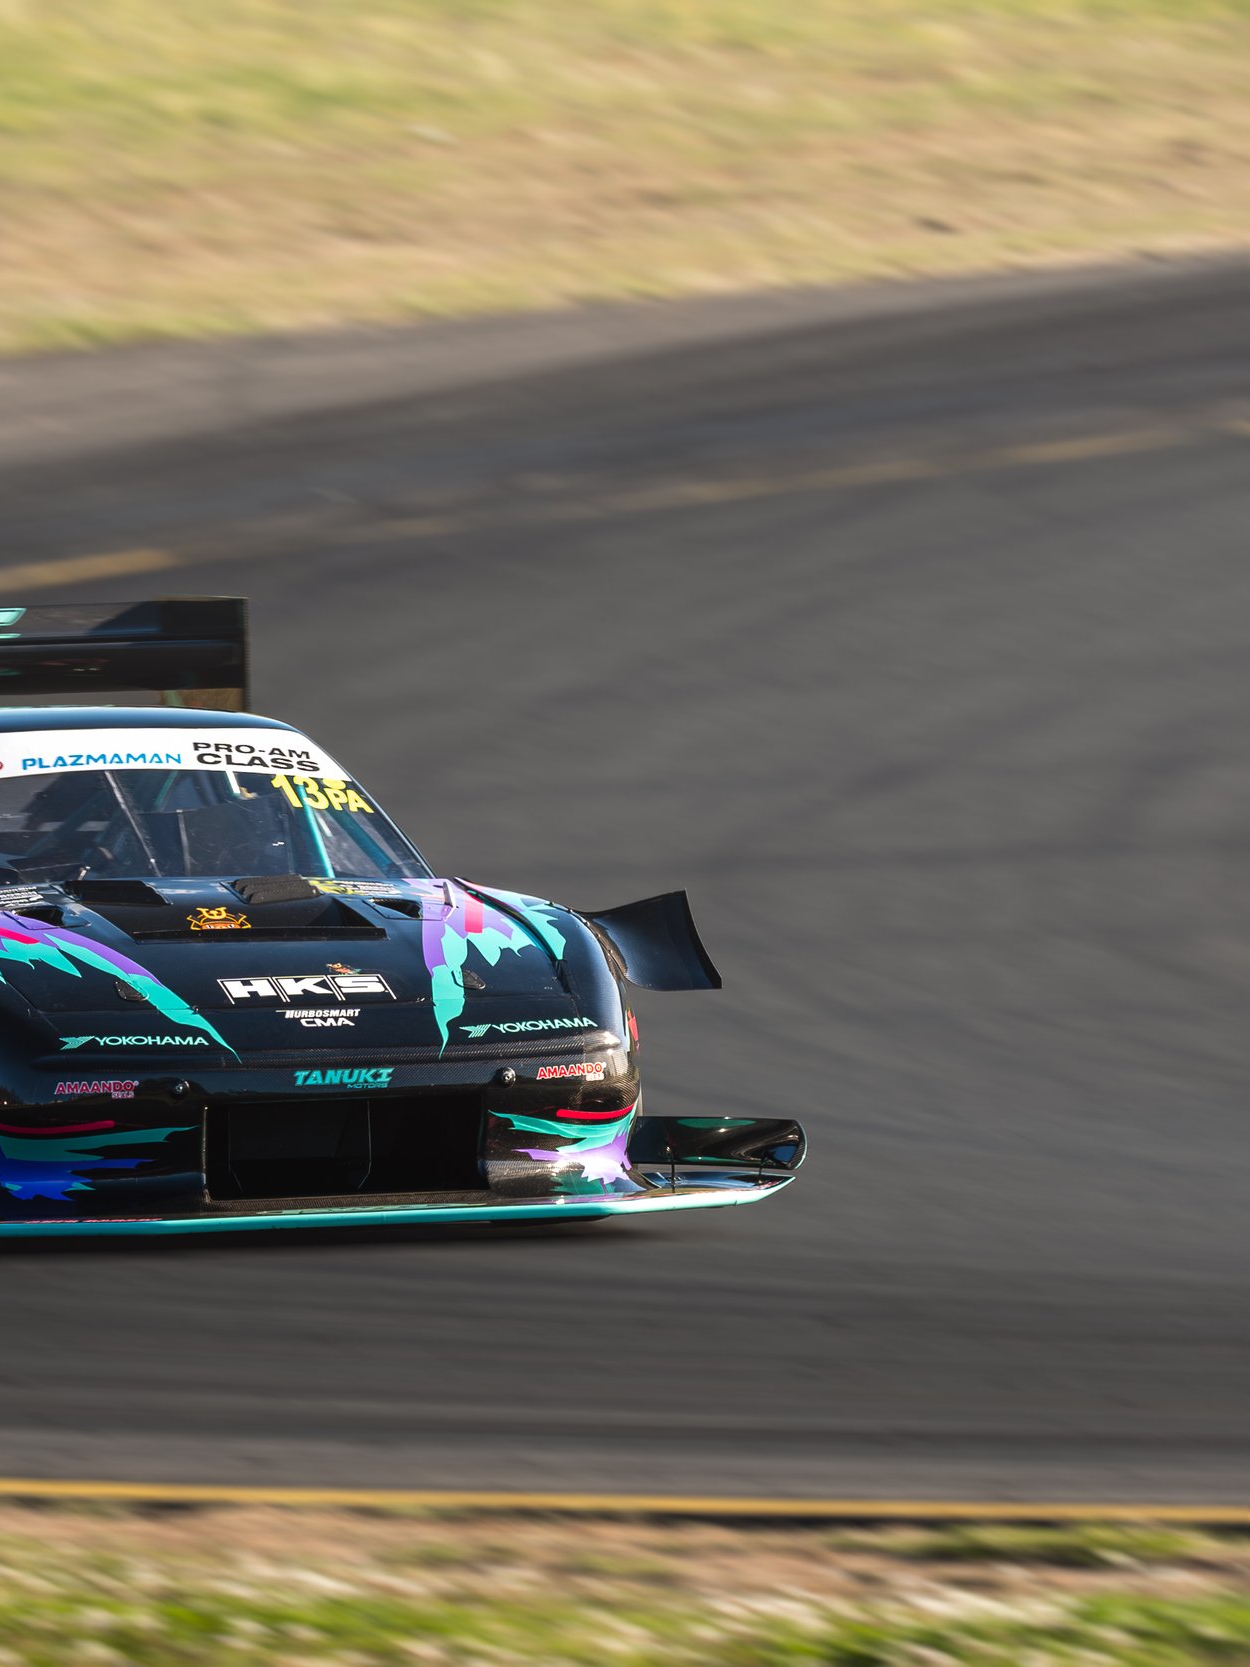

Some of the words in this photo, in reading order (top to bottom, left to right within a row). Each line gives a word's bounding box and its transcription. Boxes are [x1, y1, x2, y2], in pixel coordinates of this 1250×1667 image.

[193, 742, 310, 759] PRO-AM
[22, 753, 182, 770] PLAZMAMAN
[196, 753, 320, 772] CLASS
[222, 975, 387, 999] HKS
[300, 1018, 355, 1027] CMA
[492, 1016, 599, 1034] YOKOHAMA
[95, 1036, 209, 1046] YOKOHAMA
[293, 1067, 395, 1086] TANUKI
[536, 1063, 603, 1080] AMAANDO
[54, 1080, 136, 1095] AMAANDO
